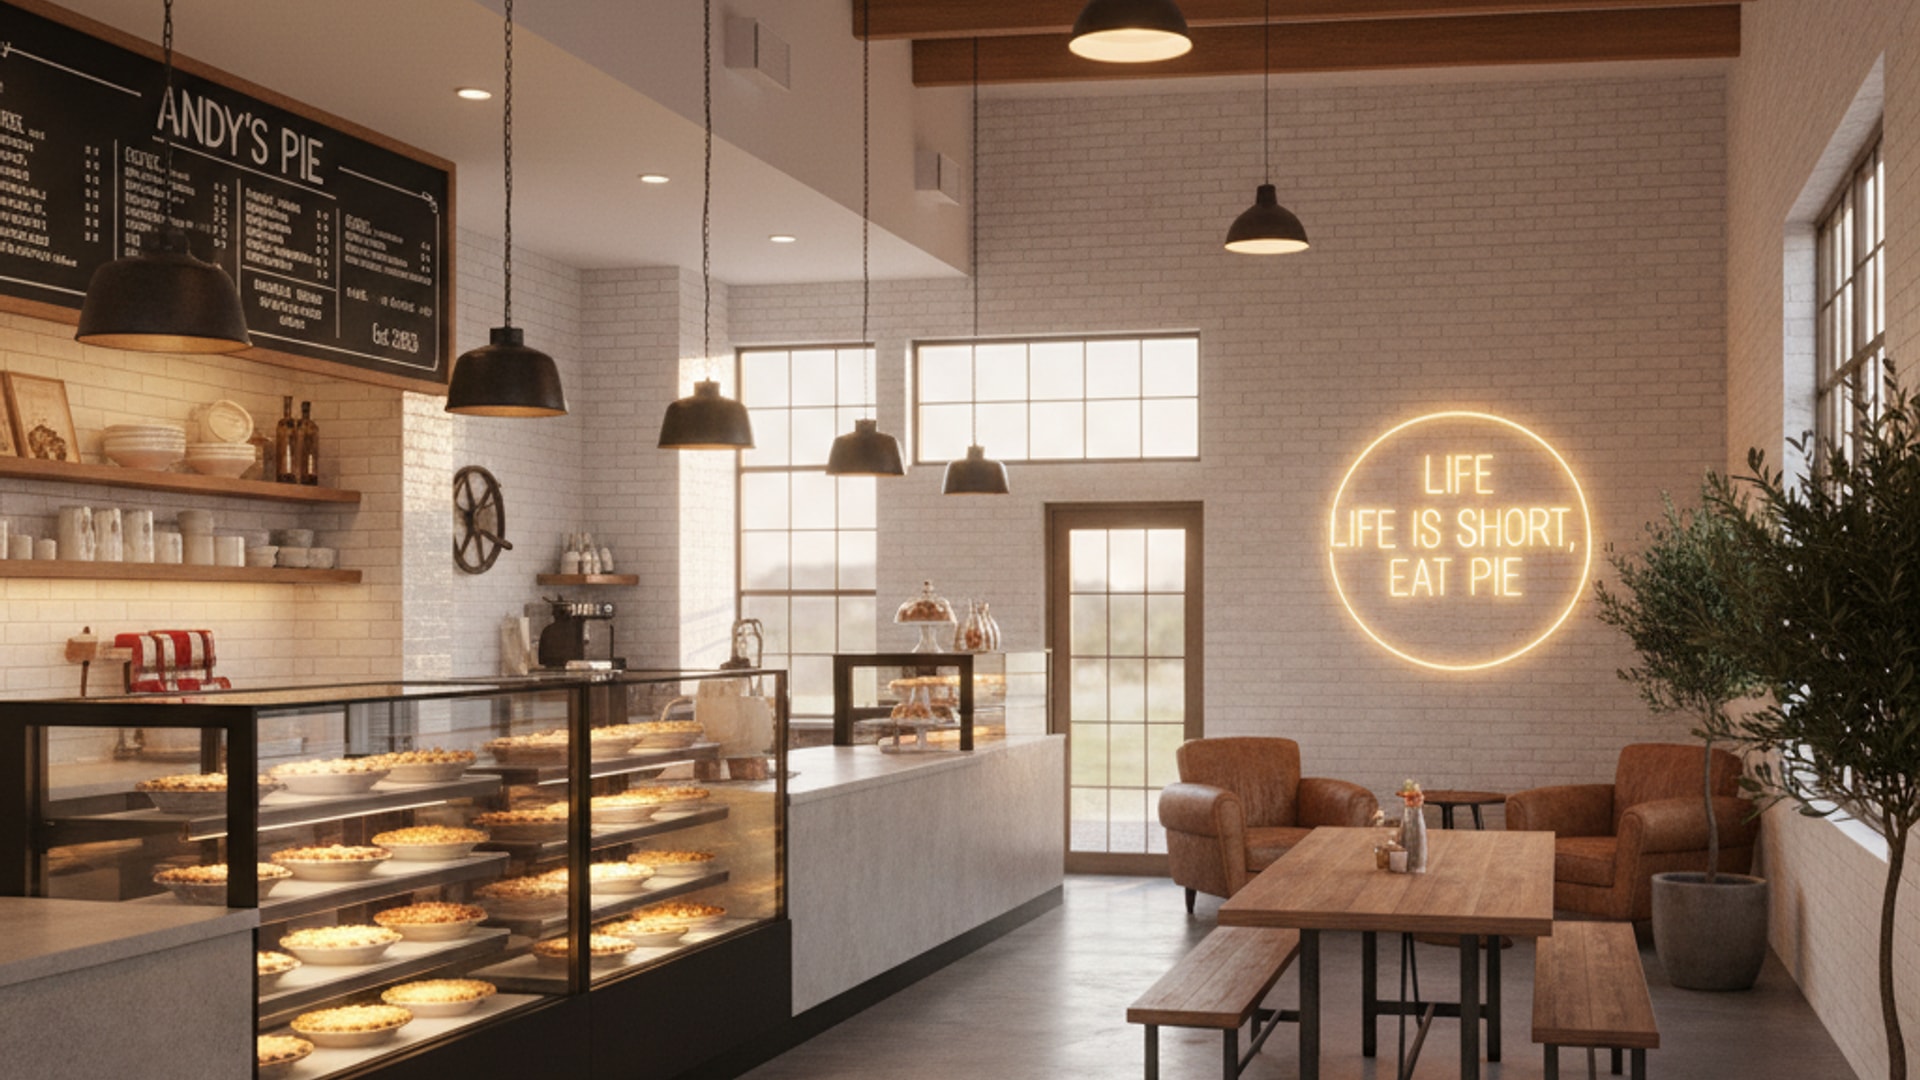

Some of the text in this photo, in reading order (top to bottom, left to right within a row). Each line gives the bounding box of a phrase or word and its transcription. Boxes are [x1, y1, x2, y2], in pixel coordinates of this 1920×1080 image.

[157, 84, 269, 166] ANDY'S
[281, 127, 324, 186] PIE
[1424, 453, 1495, 495] LIFE
[1329, 507, 1576, 553] LIFE IS SHORT,
[1389, 556, 1523, 597] EAT PIE
